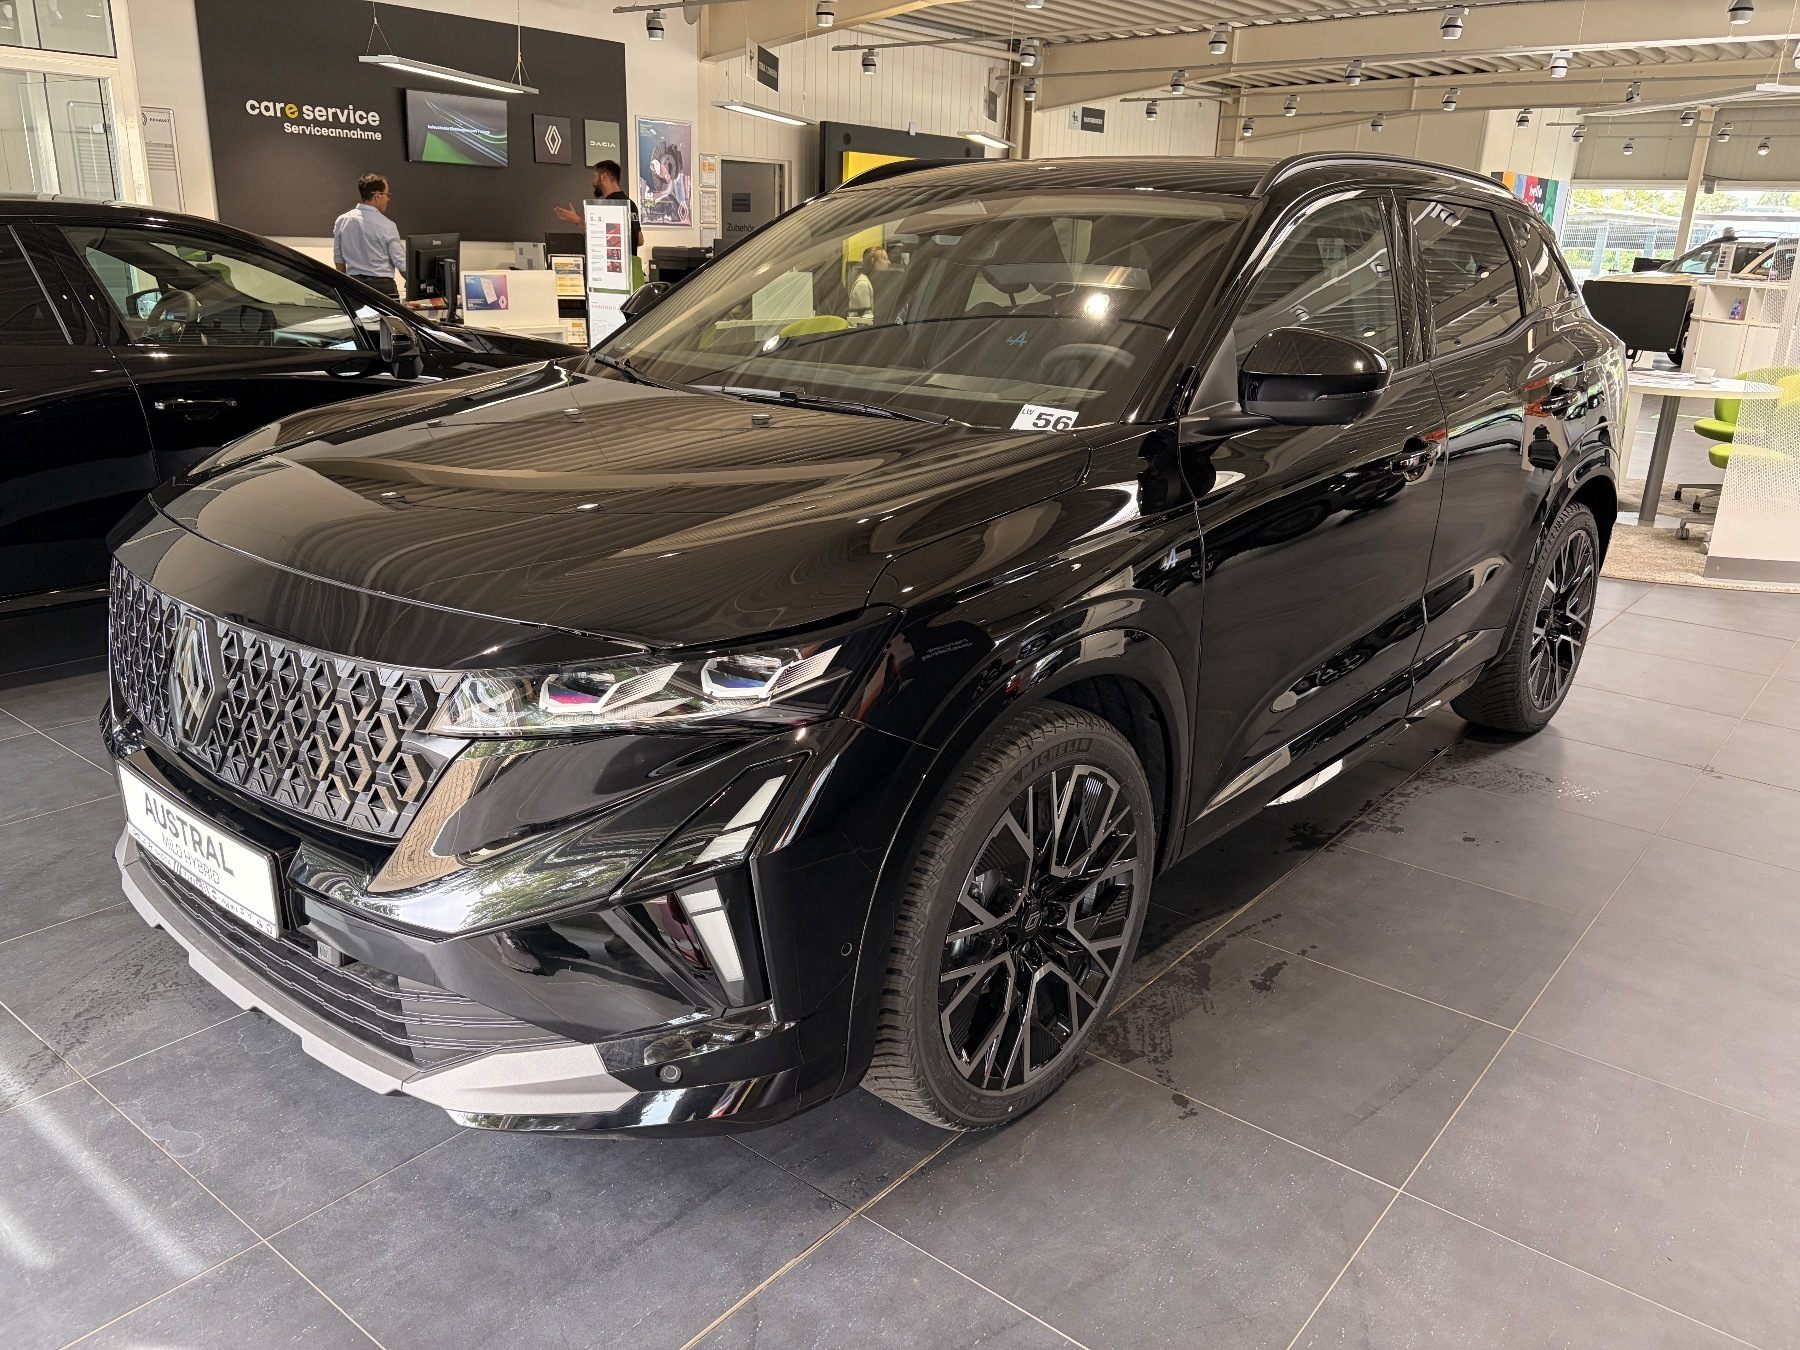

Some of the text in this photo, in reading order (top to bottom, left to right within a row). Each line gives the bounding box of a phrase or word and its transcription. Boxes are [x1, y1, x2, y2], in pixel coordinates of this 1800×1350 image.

[245, 99, 380, 126] care service
[283, 122, 382, 141] Serviceannahme
[589, 140, 616, 148] DACIA
[1021, 408, 1035, 416] LW
[1032, 412, 1073, 431] 56
[144, 791, 235, 877] AUSTRAL
[161, 832, 184, 858] MILD
[184, 850, 221, 886] HYBRID
